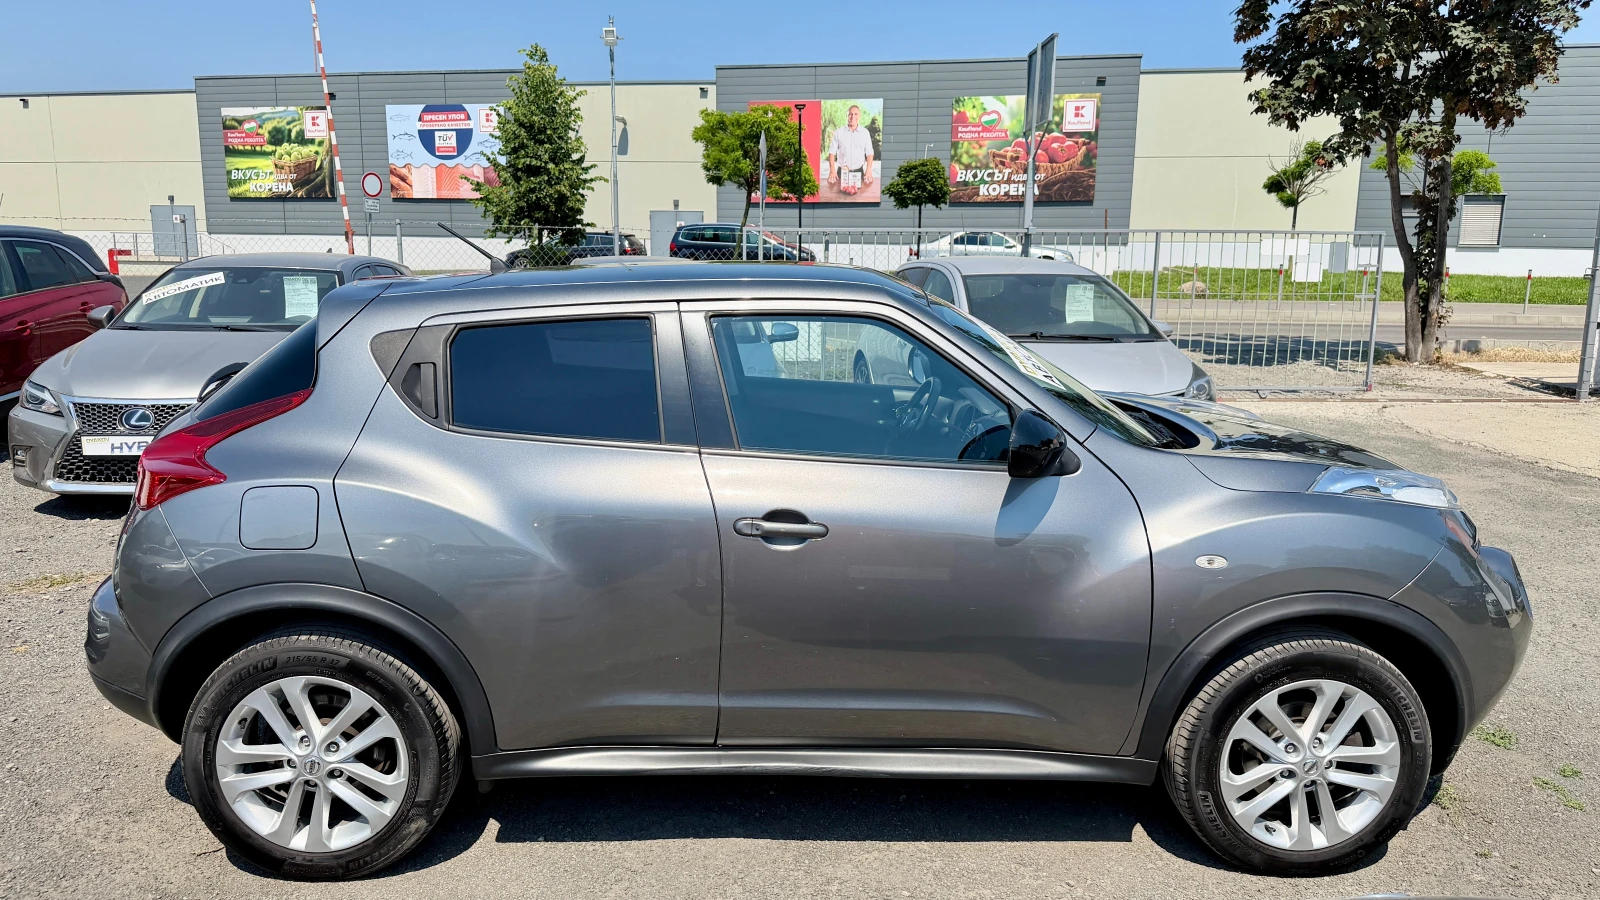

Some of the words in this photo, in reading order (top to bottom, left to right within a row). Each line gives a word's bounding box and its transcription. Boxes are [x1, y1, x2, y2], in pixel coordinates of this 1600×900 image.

[231, 170, 272, 180] ВКУСЪТ
[956, 170, 1012, 182] ВКУСЪТ
[250, 182, 294, 192] КОРЕНА
[145, 276, 223, 303] АВТОМАТИК
[284, 654, 317, 664] 215/55
[208, 656, 276, 707] MICHELIN
[1383, 680, 1426, 742] MICHELIN
